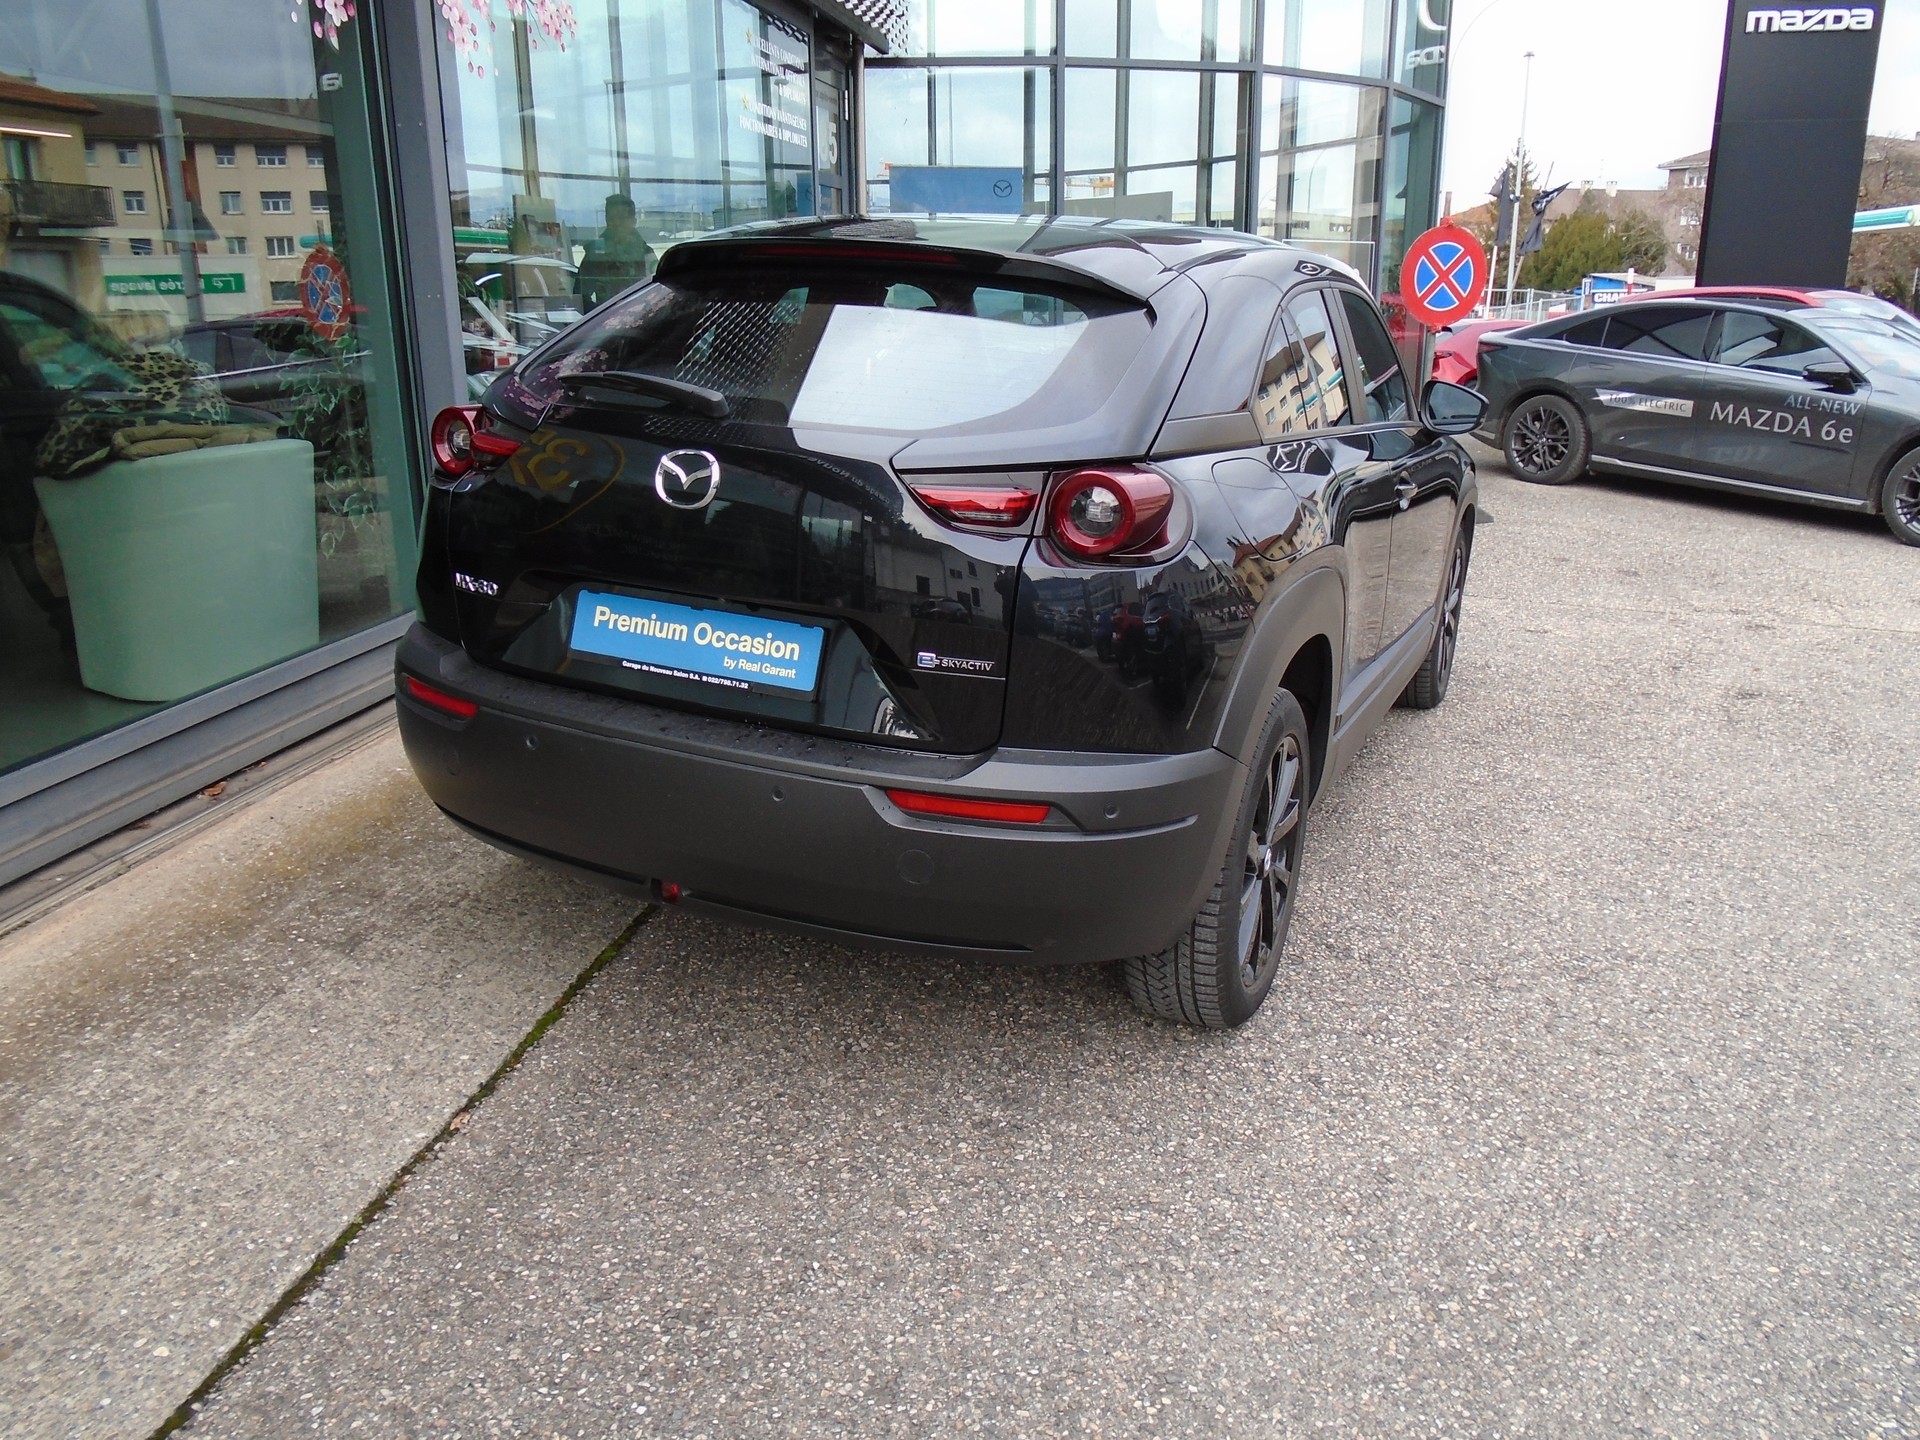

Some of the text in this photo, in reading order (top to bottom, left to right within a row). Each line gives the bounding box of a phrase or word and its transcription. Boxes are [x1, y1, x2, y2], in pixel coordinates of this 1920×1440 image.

[1745, 8, 1874, 33] mazda
[1638, 398, 1687, 413] ELECTRIC
[1784, 394, 1862, 416] ALL-NEW
[1710, 401, 1854, 444] MAZDA 6e
[594, 605, 800, 661] Premium Occasion
[622, 660, 641, 671] Garage
[649, 666, 673, 677] Nouveau
[673, 669, 689, 680] Salon
[689, 673, 701, 682] S.A.
[723, 656, 796, 679] by Real Garant
[941, 658, 993, 672] SKYACTIV
